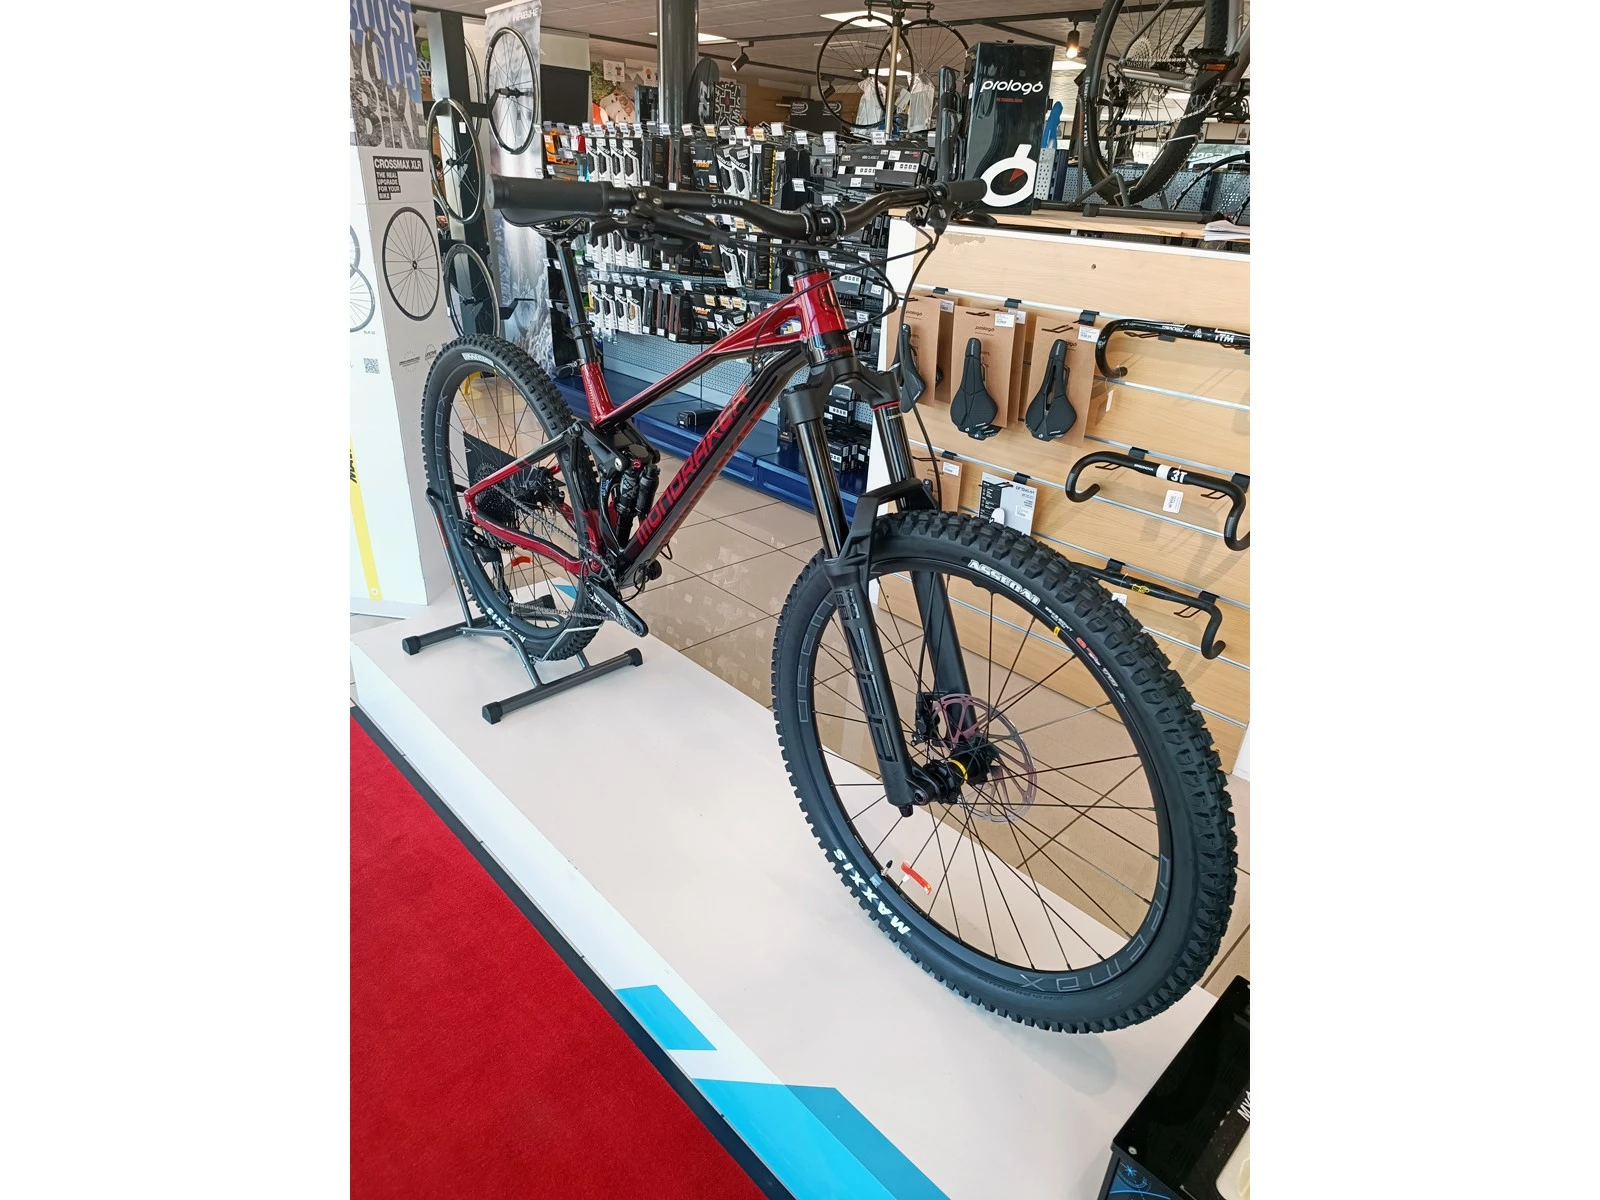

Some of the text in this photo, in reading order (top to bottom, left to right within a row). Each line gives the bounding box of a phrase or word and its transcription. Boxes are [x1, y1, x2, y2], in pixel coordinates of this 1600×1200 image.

[350, 0, 416, 46] OOST
[374, 158, 422, 170] CROSSMAX XLR
[1214, 333, 1236, 344] ITM
[1170, 469, 1188, 484] 3T
[967, 558, 1042, 606] ASSEGAI
[486, 606, 527, 643] MXXIS
[833, 848, 911, 935] MAXXIS
